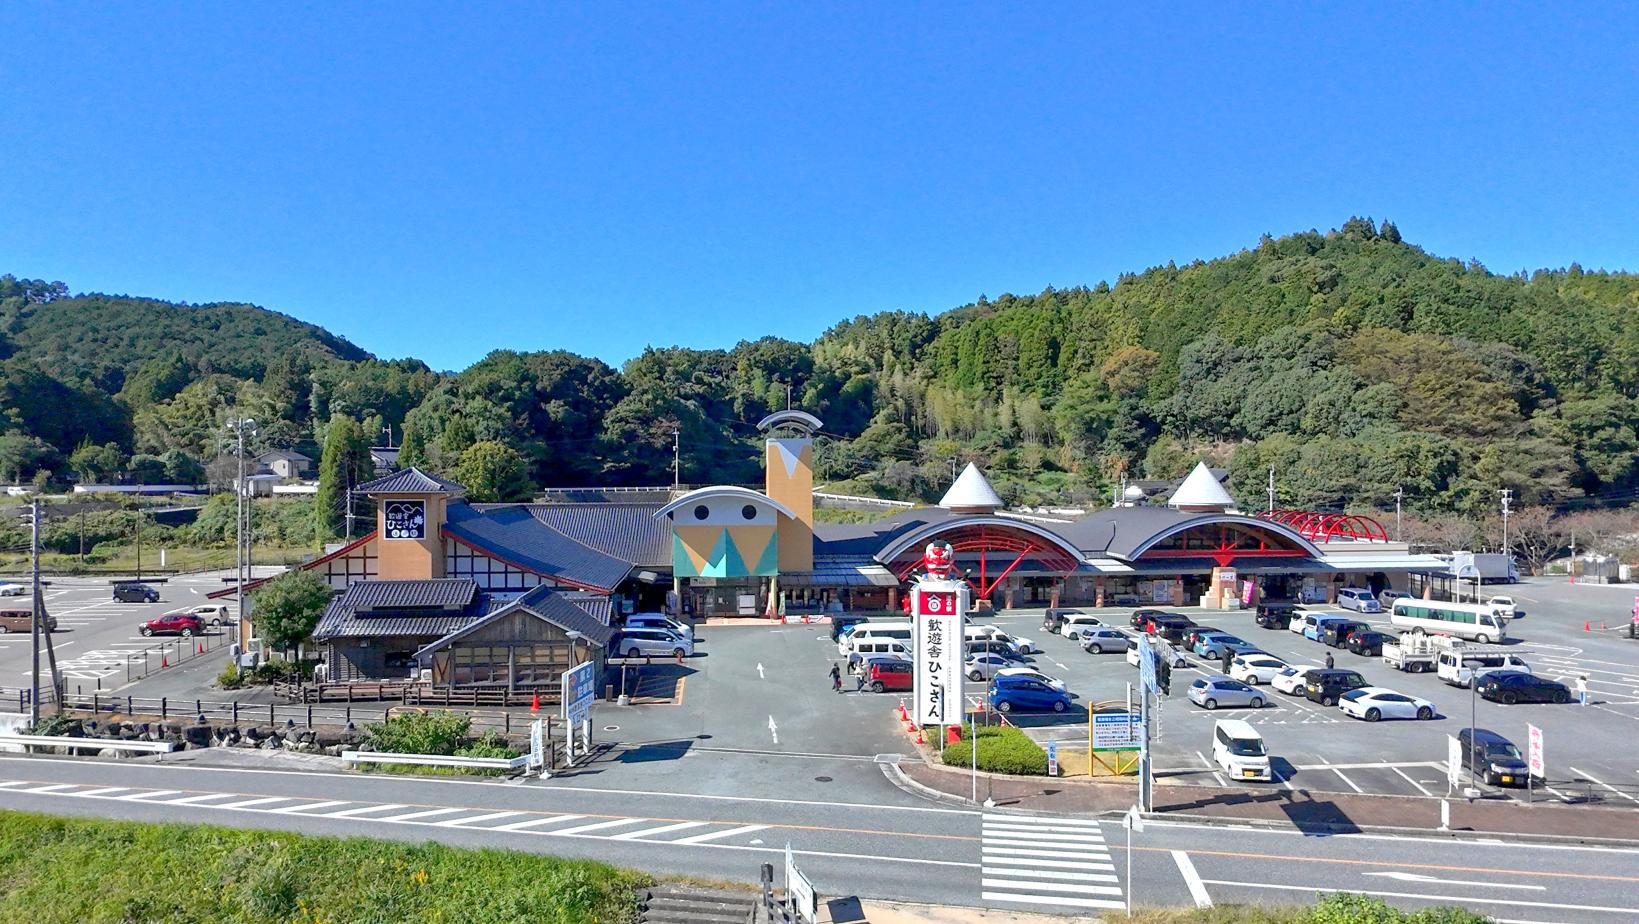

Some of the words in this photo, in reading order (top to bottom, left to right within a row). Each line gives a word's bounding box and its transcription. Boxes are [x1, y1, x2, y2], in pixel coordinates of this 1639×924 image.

[387, 519, 419, 530] ひこさん
[928, 619, 942, 717] 歓遊舎ひこさん
